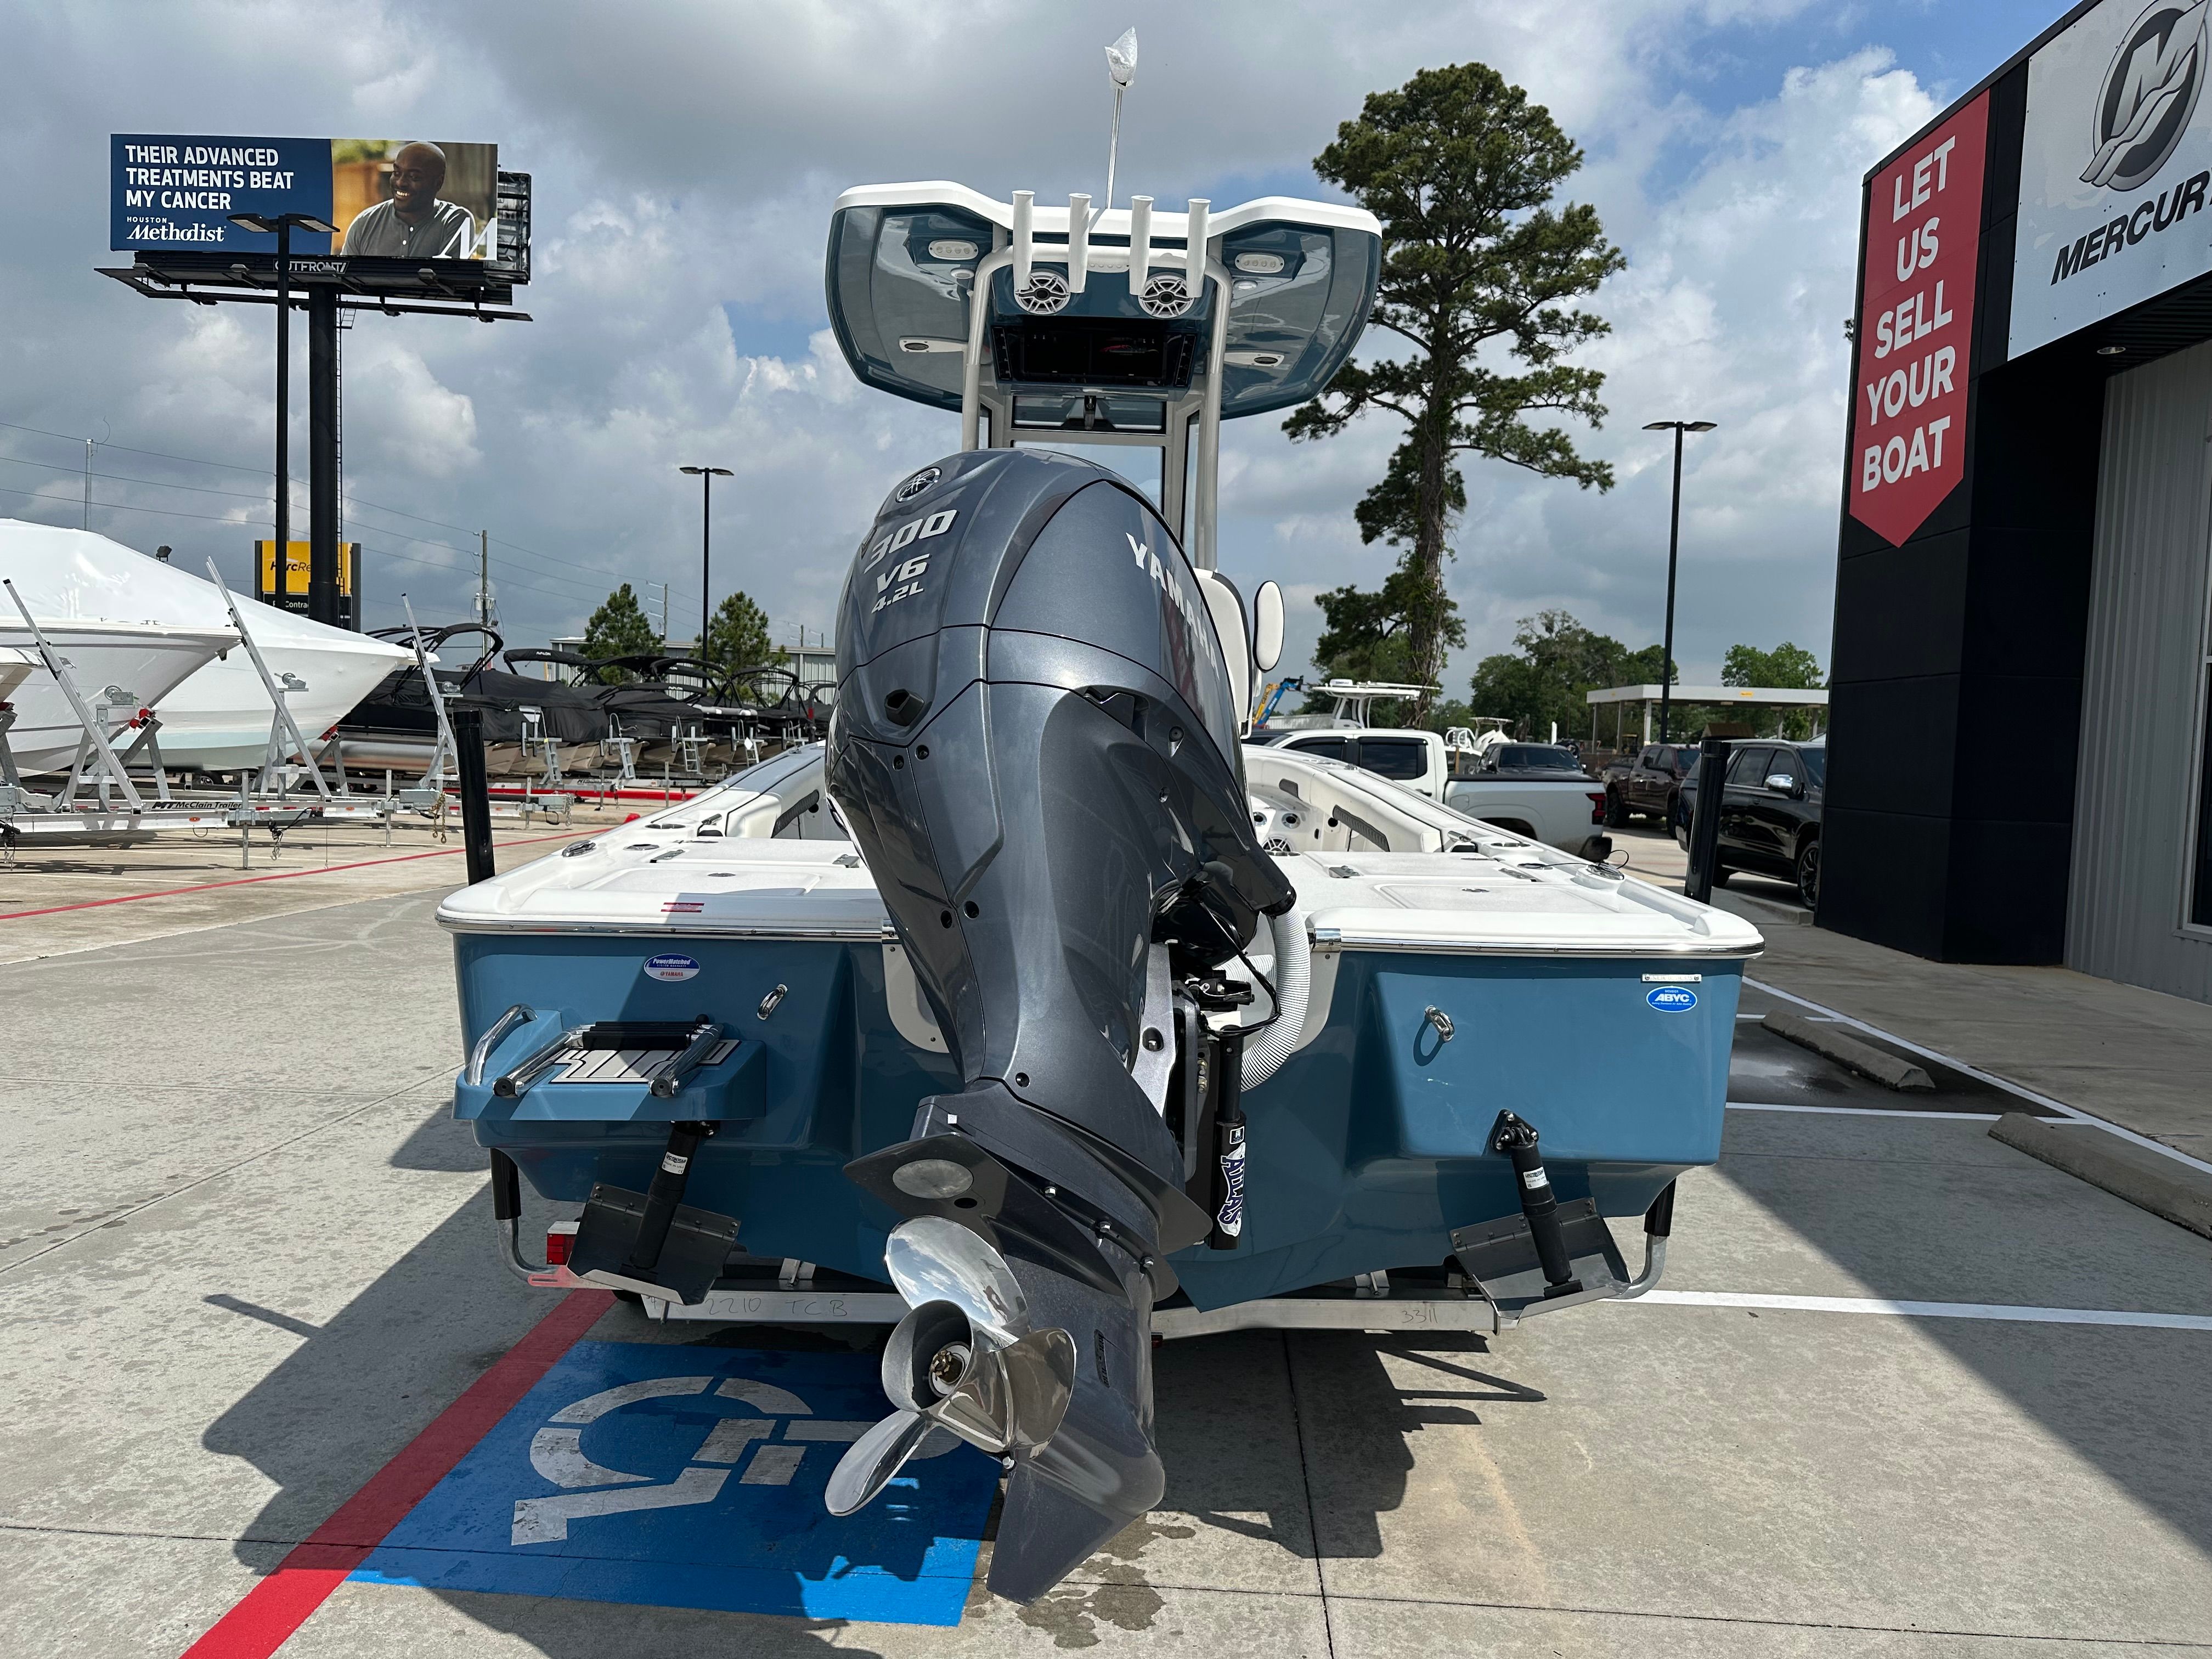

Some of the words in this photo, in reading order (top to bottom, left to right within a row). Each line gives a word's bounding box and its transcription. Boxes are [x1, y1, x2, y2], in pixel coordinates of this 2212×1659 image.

[125, 145, 178, 164] THEIR
[184, 146, 279, 167] ADVANCED
[126, 167, 245, 188] TREATMENTS
[250, 171, 294, 189] BEAT
[1892, 135, 1956, 224] LET
[126, 190, 159, 207] MY
[161, 191, 231, 210] CANCER
[127, 222, 225, 242] Methodist
[2050, 169, 2212, 286] MERCUR
[1895, 216, 1940, 283] US
[1874, 279, 1954, 360] SELL
[1866, 344, 1956, 427] YOUR
[1862, 414, 1951, 494] BOAT
[864, 509, 958, 574] 300
[877, 553, 930, 594] V6
[871, 581, 924, 614] 4.2L
[1126, 532, 1220, 681] YAMAHA
[1654, 994, 1690, 1003] ABYC
[1217, 1155, 1245, 1224] ATLAS
[1401, 1307, 1438, 1324] 3311
